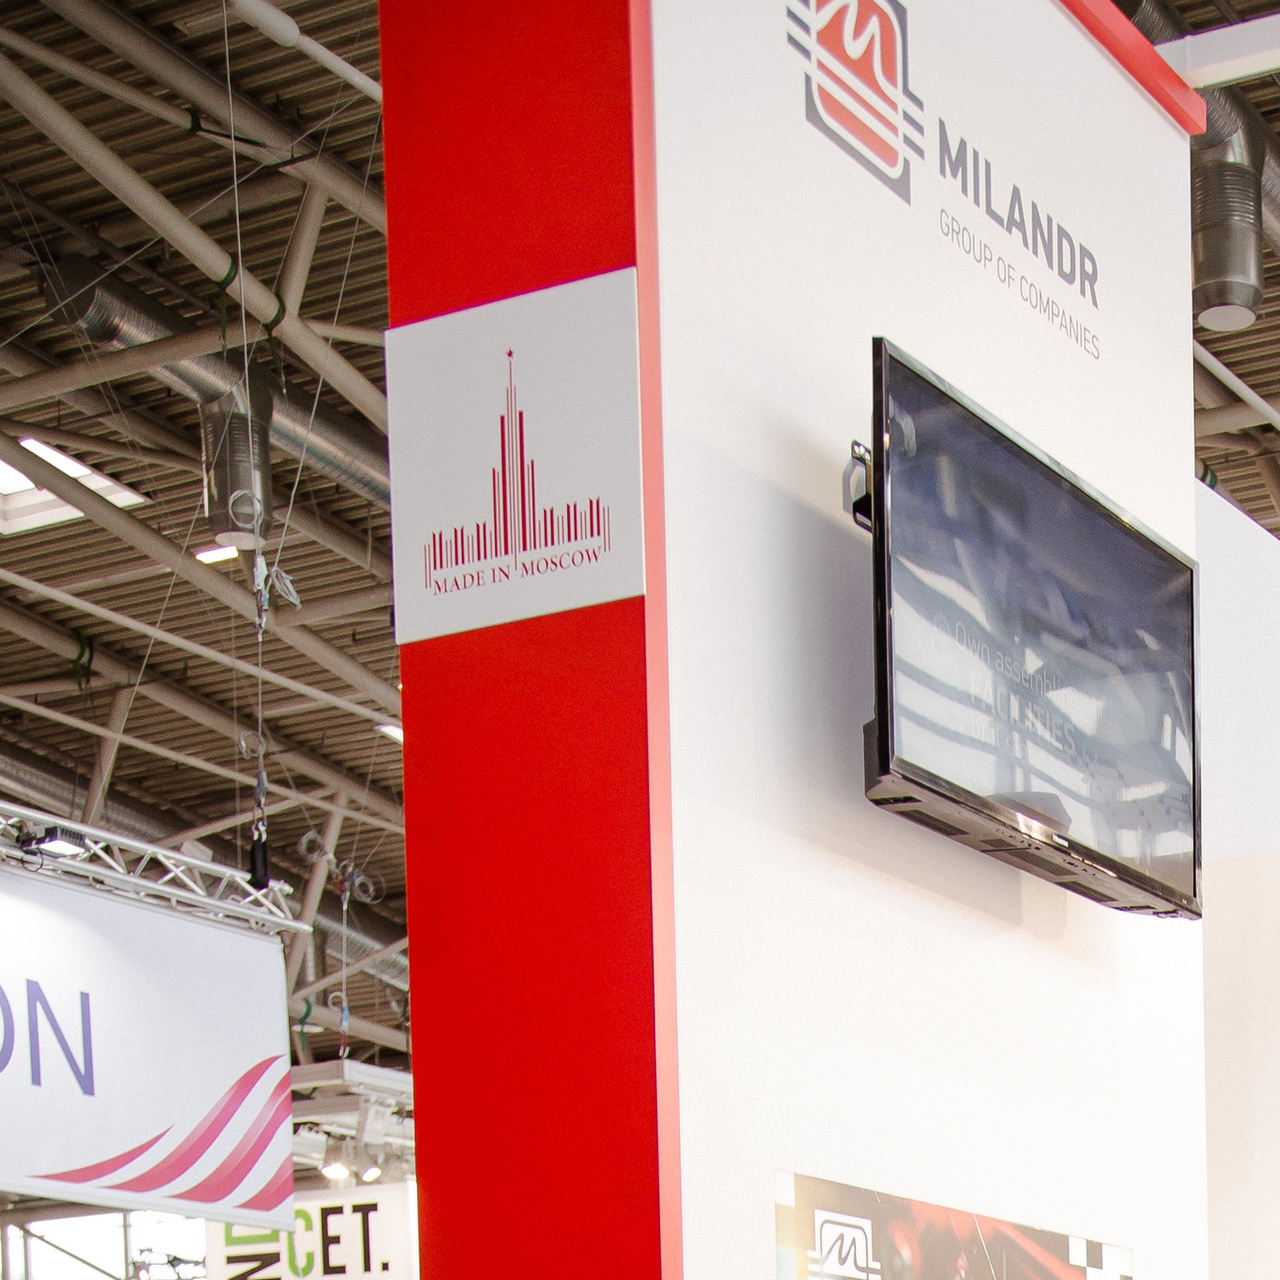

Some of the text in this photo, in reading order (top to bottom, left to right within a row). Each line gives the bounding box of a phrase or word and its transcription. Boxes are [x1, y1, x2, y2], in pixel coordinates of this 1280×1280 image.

[938, 116, 1099, 310] MILANDR
[939, 208, 1100, 360] GROUP OF COMPANIES
[433, 546, 602, 596] MADE IN MOSCOW
[0, 978, 95, 1096] N
